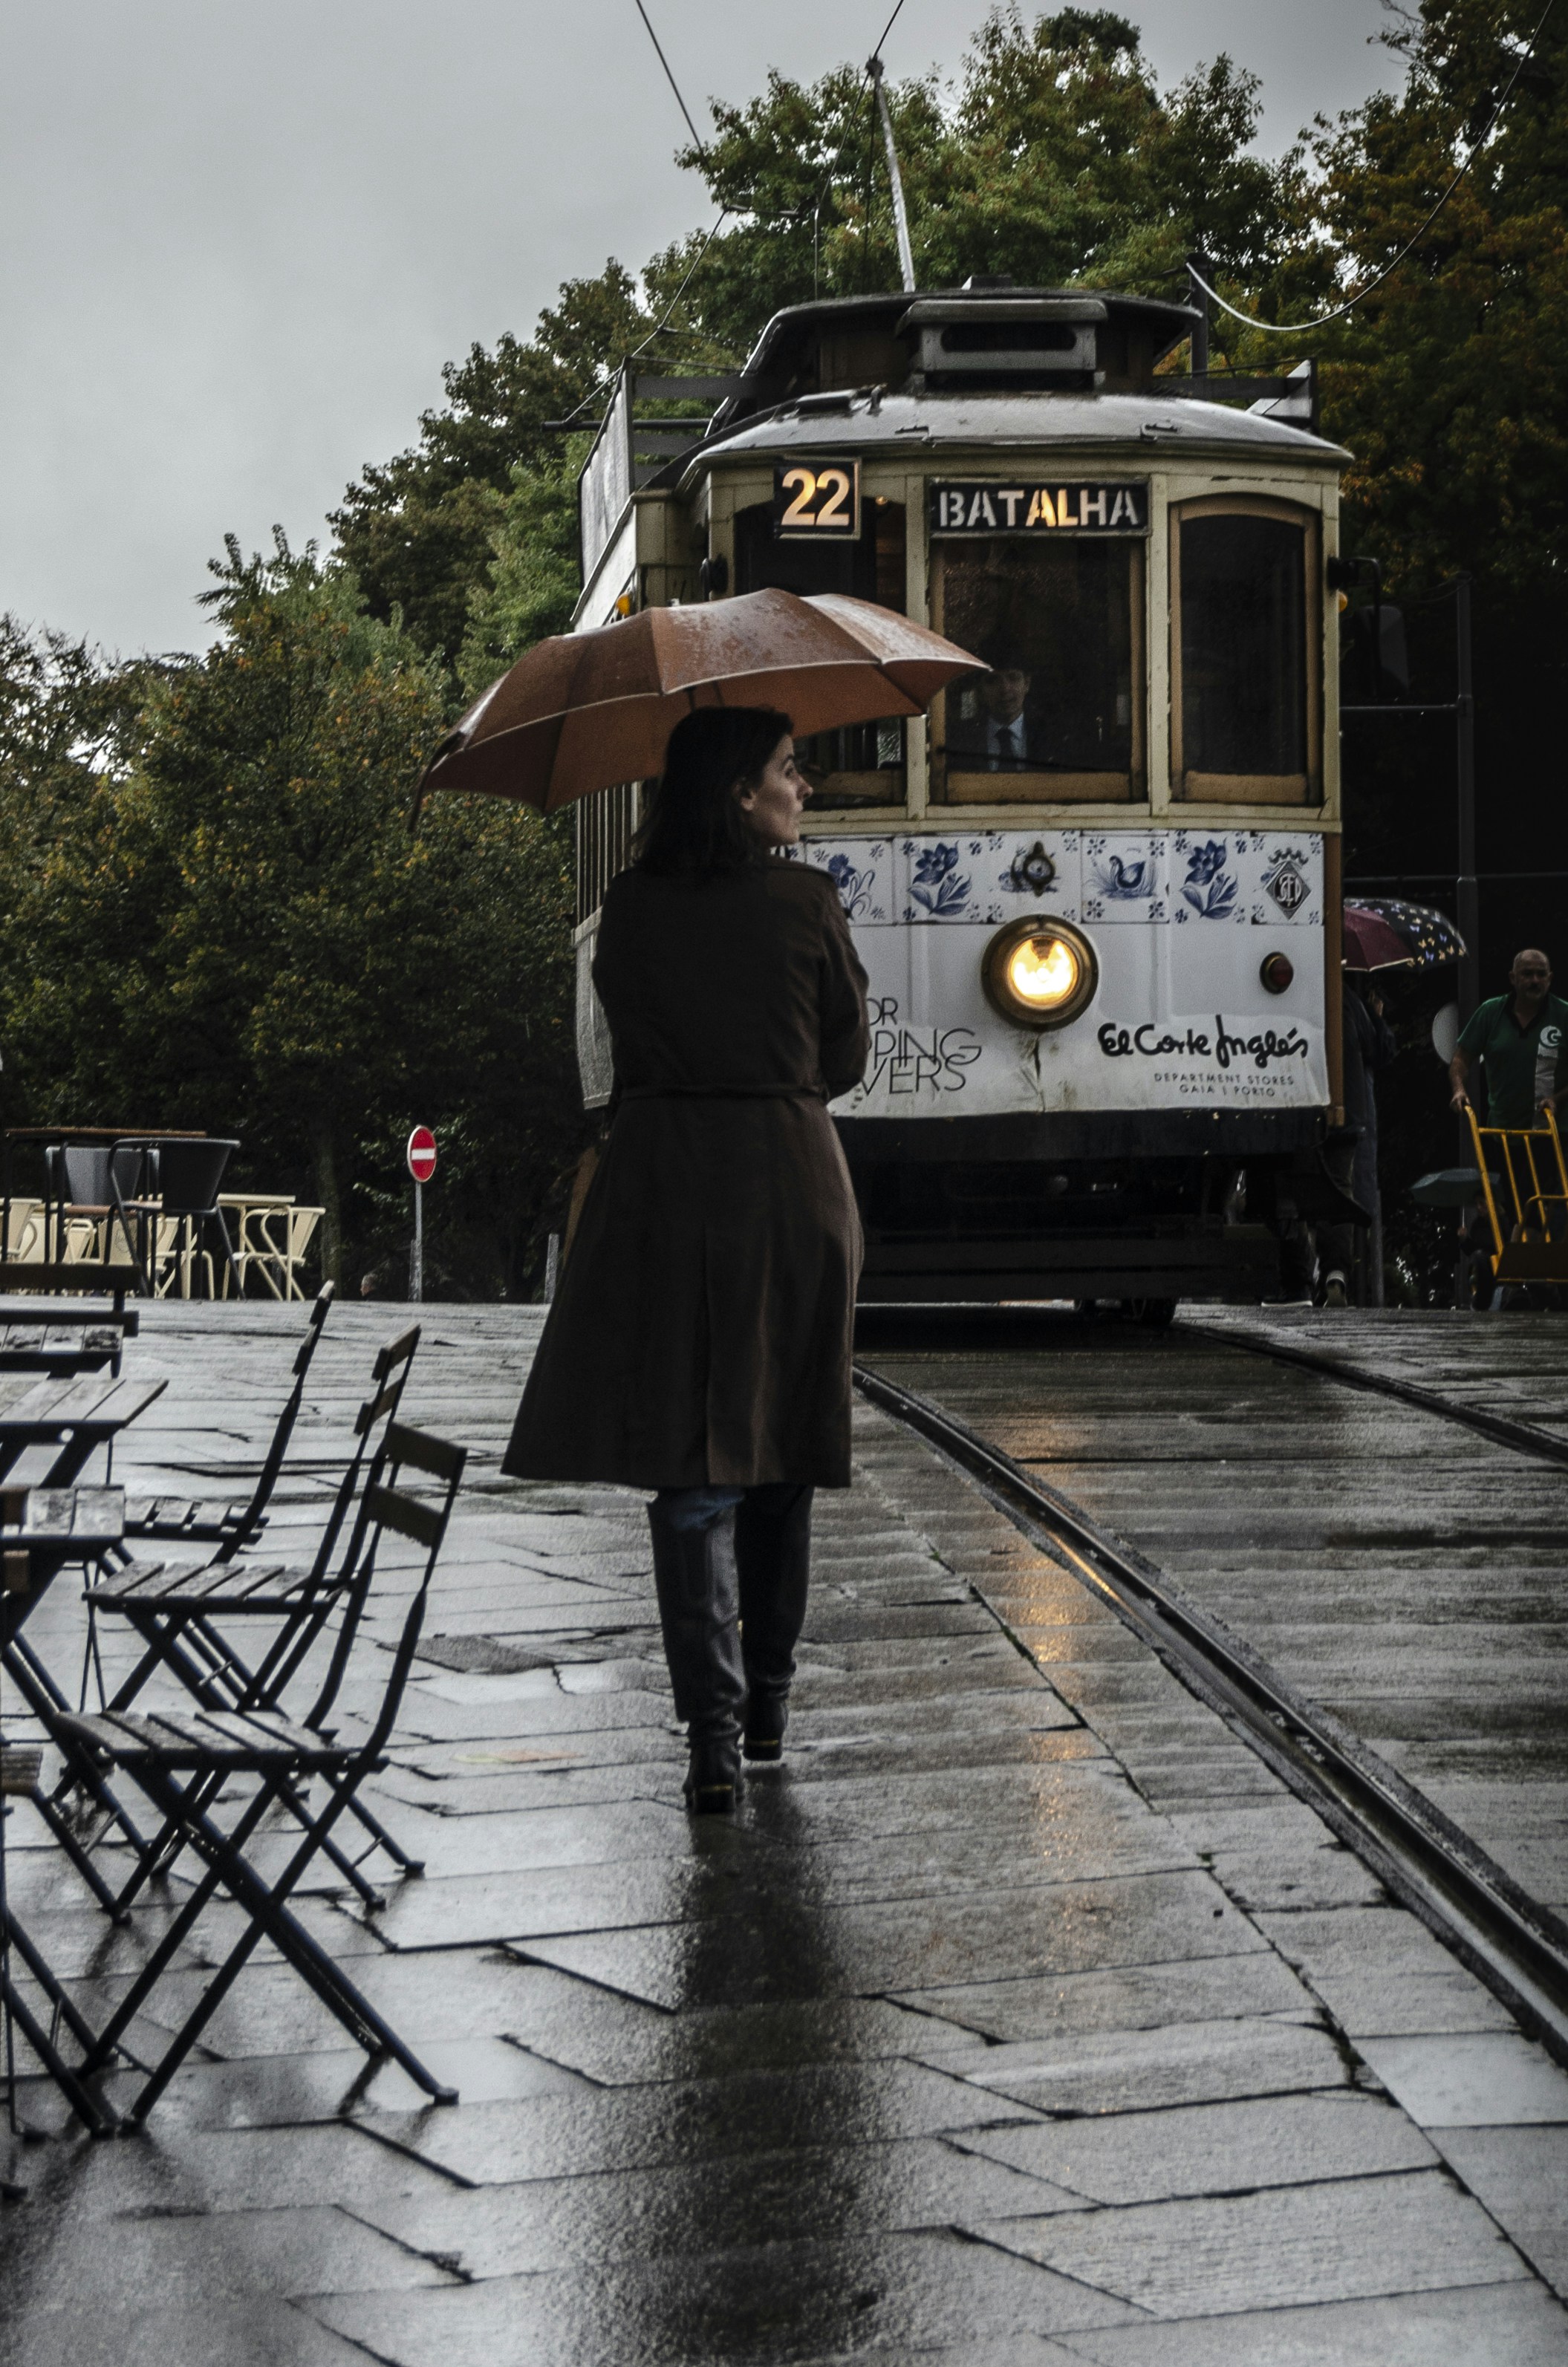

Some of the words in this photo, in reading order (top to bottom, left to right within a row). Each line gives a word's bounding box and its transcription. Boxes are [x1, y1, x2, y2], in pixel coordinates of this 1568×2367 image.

[781, 468, 850, 526] 22
[939, 489, 1139, 527] BATALHA
[868, 1028, 981, 1070] PING
[1097, 1023, 1133, 1057] El
[1134, 1023, 1211, 1056] Corte
[1154, 1072, 1240, 1084] DEPARTMENT
[1247, 1075, 1295, 1086] STORES
[1179, 1084, 1214, 1094] GAIA
[1233, 1085, 1275, 1097] PORTO
